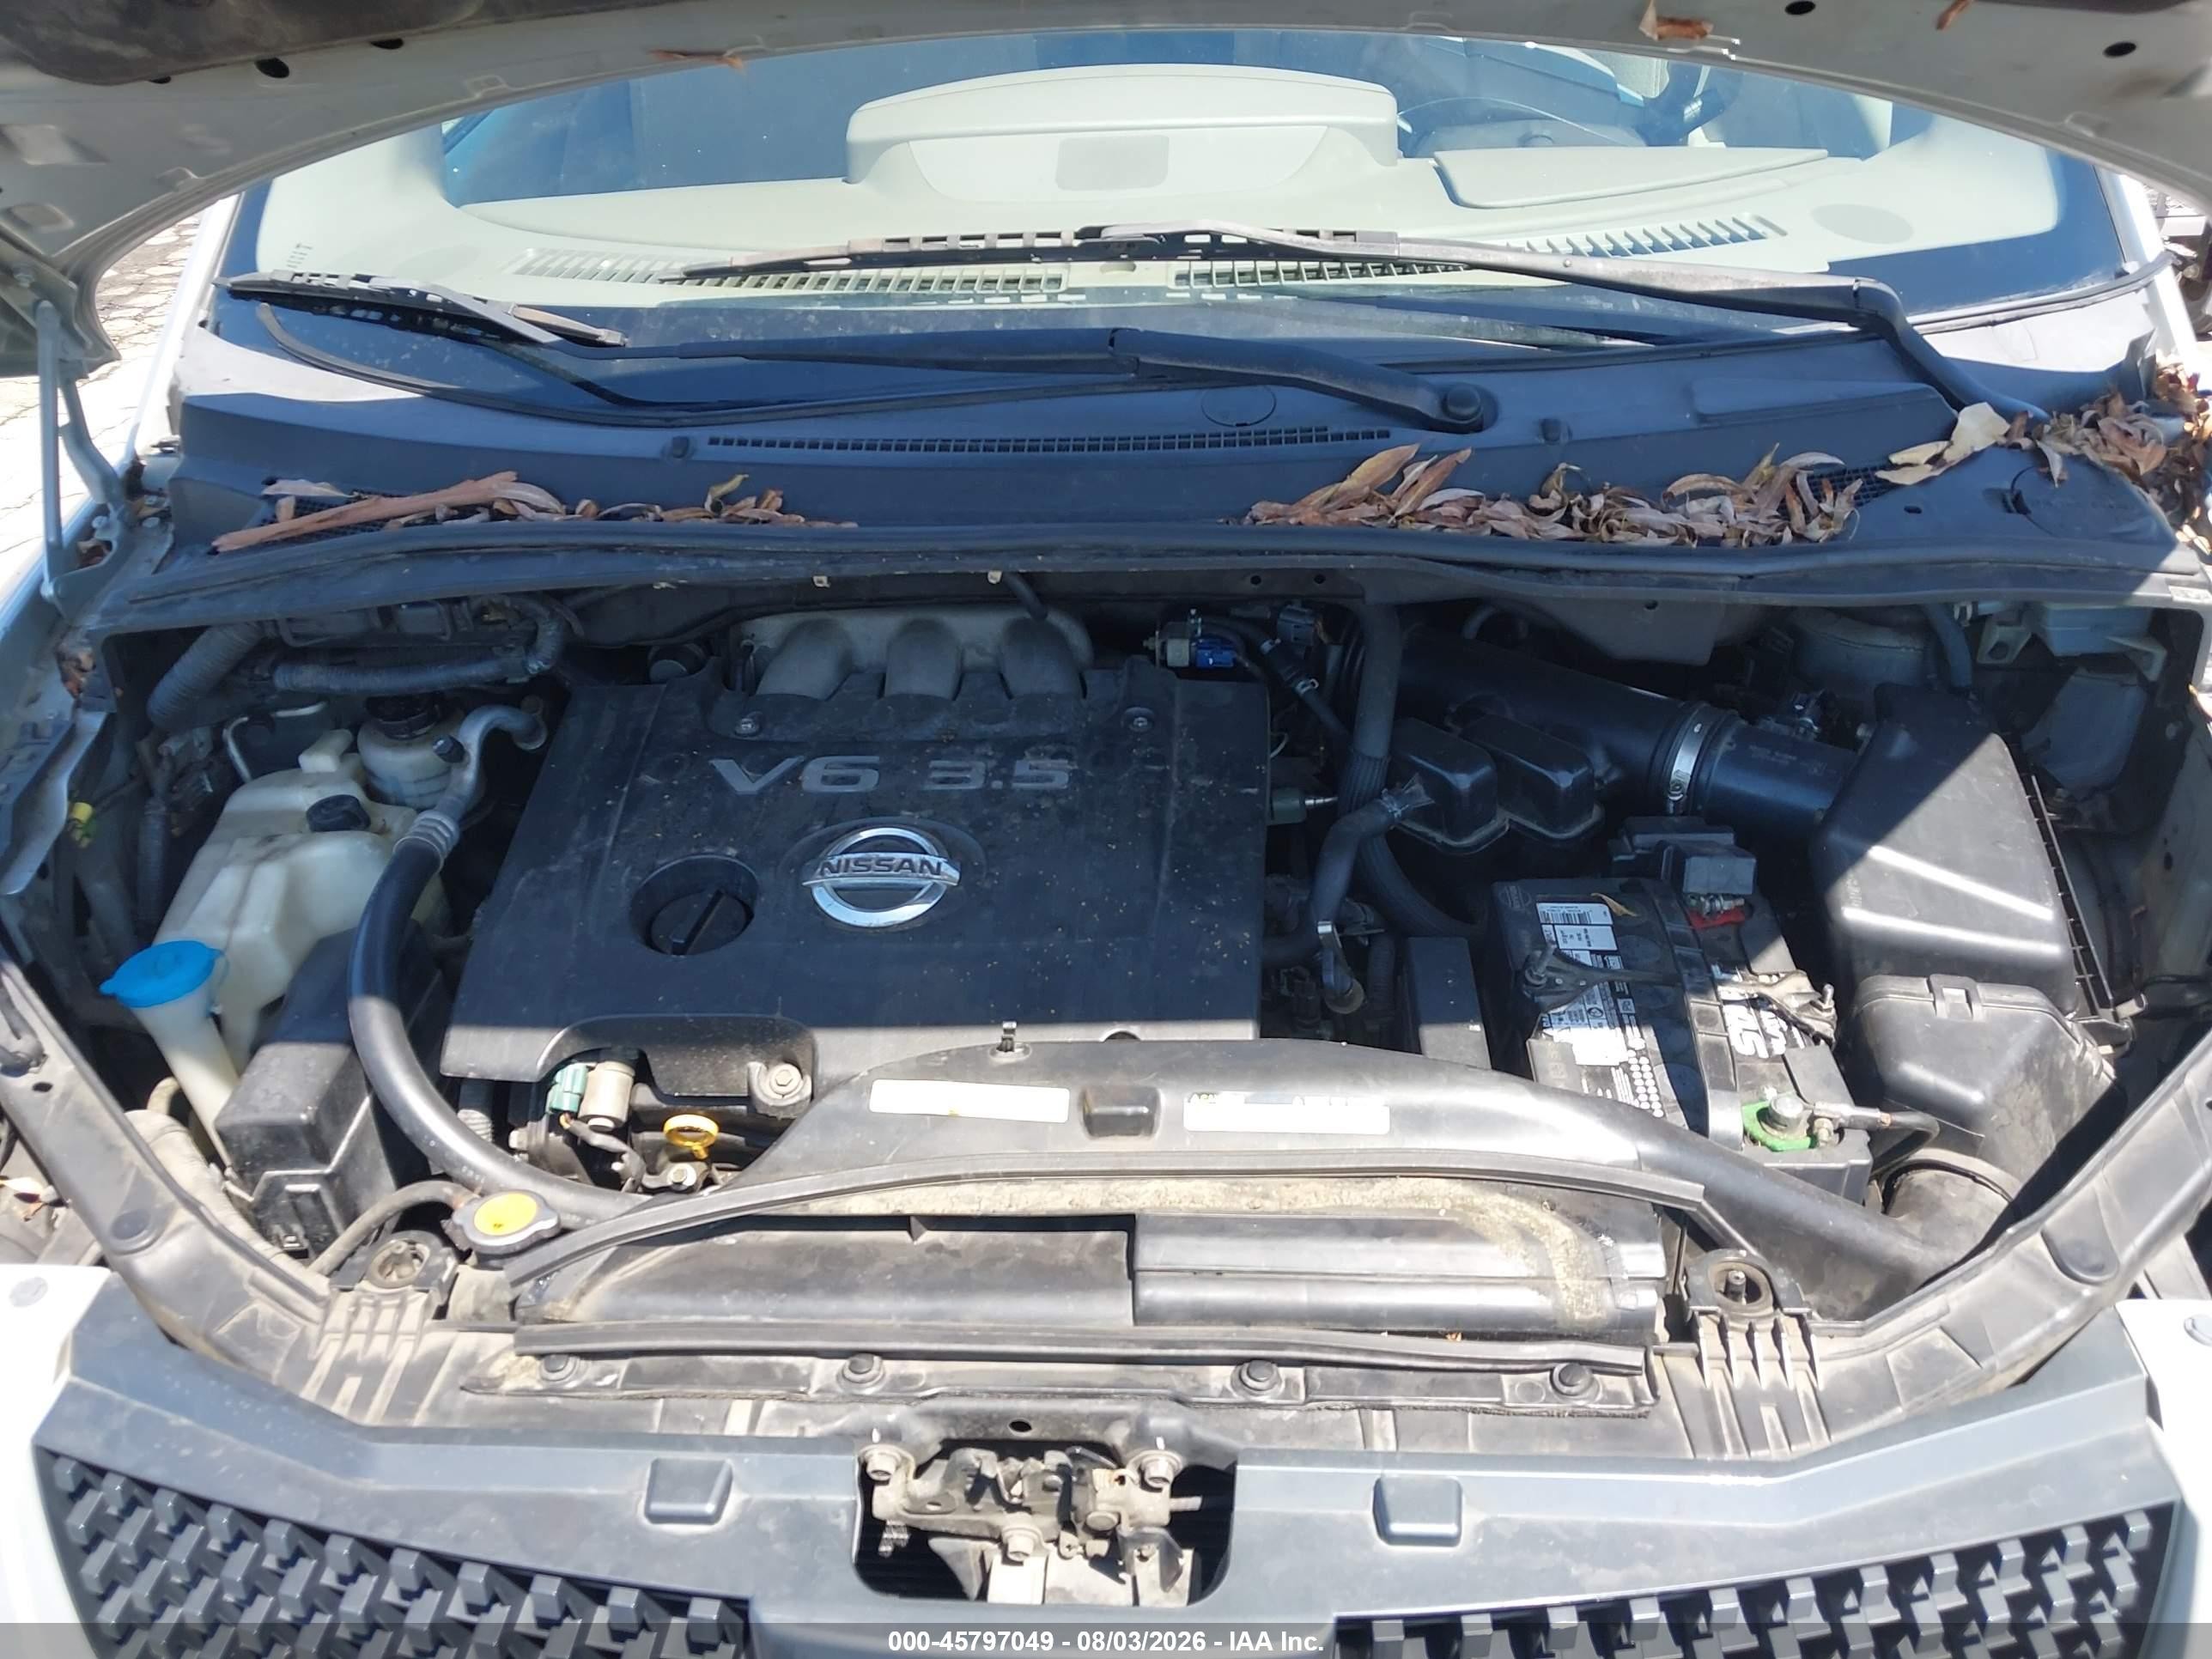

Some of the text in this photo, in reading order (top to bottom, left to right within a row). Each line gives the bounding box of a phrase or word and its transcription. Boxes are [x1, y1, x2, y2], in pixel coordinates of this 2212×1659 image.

[709, 755, 1070, 795] V6 3.5
[818, 857, 943, 877] NISSAN
